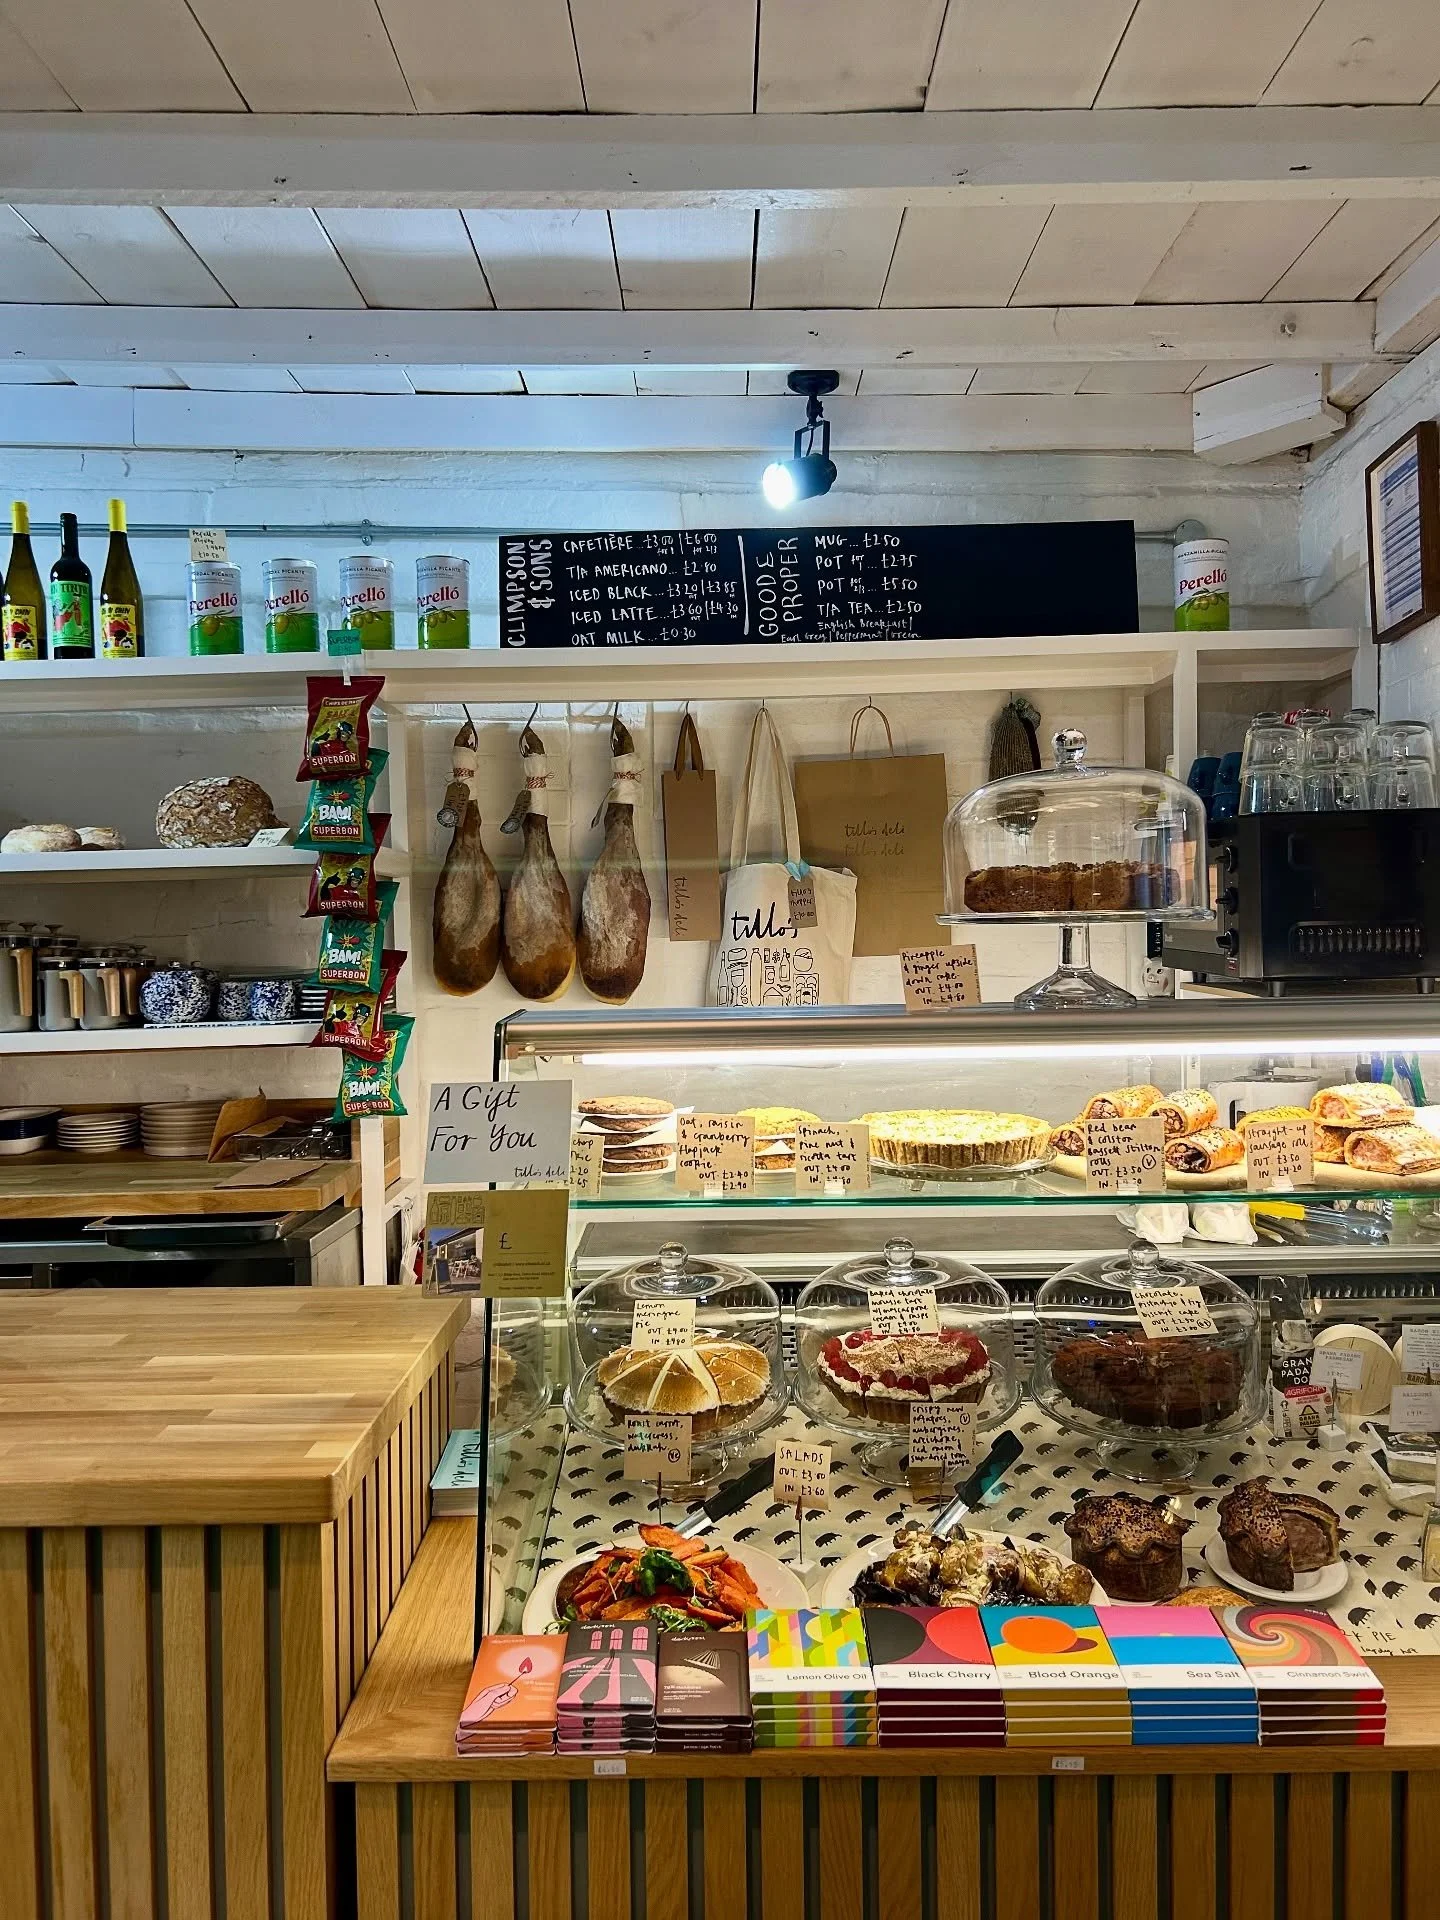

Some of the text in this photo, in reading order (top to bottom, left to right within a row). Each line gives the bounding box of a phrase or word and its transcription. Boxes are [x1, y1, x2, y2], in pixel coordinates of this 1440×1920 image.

[815, 535, 847, 549] MUG
[816, 555, 844, 570] POT
[527, 539, 556, 609] & SONS
[595, 563, 668, 578] AMERICANO
[778, 536, 804, 622] PROPER
[1179, 568, 1228, 596] Perelló
[570, 588, 600, 601] ICED
[607, 586, 652, 599] BLACK
[818, 578, 845, 595] POT
[506, 542, 527, 647] CLIMPSON
[756, 574, 779, 637] GOOD
[848, 602, 873, 614] TEA
[571, 610, 601, 625] ICED
[612, 606, 658, 621] LATTE
[817, 621, 855, 630] English
[571, 632, 596, 646] OAT
[606, 630, 645, 645] MILK
[312, 754, 357, 766] SUPERBON
[313, 826, 359, 835] SUPERBON
[881, 821, 905, 837] deli
[328, 948, 362, 965] BAM!
[902, 949, 945, 961] Pineapple
[913, 961, 940, 974] ginger
[945, 956, 973, 971] upside
[322, 969, 366, 979] SUPERBON
[906, 976, 932, 987] down
[348, 1080, 381, 1098] BAM!
[434, 1084, 521, 1123] A Gift
[708, 1117, 744, 1129] raisin
[1087, 1122, 1137, 1134] Red bean
[430, 1123, 537, 1152] For You
[693, 1131, 751, 1148] cranberry
[799, 1140, 820, 1150] pine
[825, 1138, 844, 1149] nut
[1249, 1139, 1287, 1153] sausage
[1089, 1157, 1111, 1166] rolls
[545, 1165, 566, 1178] deli
[636, 1302, 666, 1310] Lemon
[636, 1310, 681, 1320] meringue
[912, 1404, 941, 1415] crispy
[779, 1446, 824, 1466] SALADS
[947, 1671, 991, 1680] Cherry
[1070, 1670, 1119, 1680] Orange
